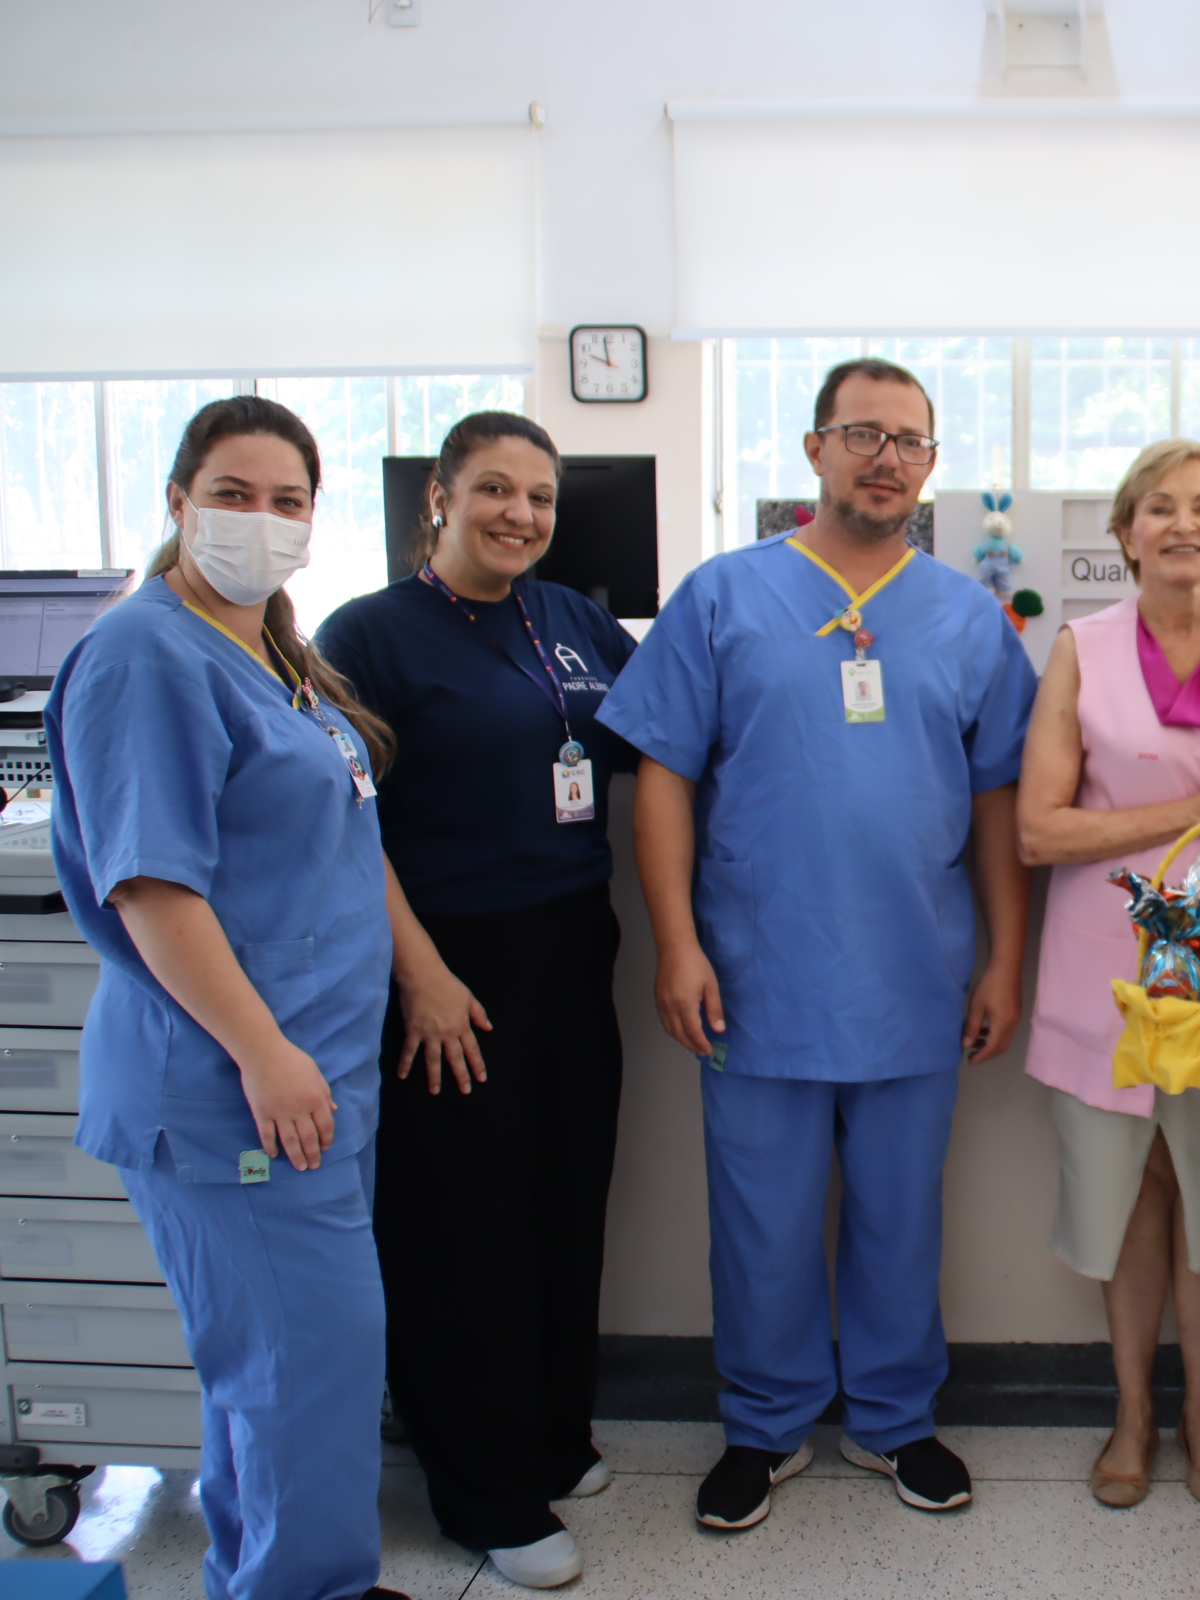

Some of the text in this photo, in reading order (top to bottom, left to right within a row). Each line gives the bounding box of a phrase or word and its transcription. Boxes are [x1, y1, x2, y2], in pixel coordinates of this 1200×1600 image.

[581, 343, 591, 353] 10
[630, 342, 637, 352] 2
[581, 358, 588, 369] 9
[631, 359, 638, 368] 3
[581, 374, 588, 384] 8
[631, 374, 638, 384] 4
[606, 383, 614, 393] 6
[621, 383, 628, 393] 5
[562, 682, 589, 692] PADRE
